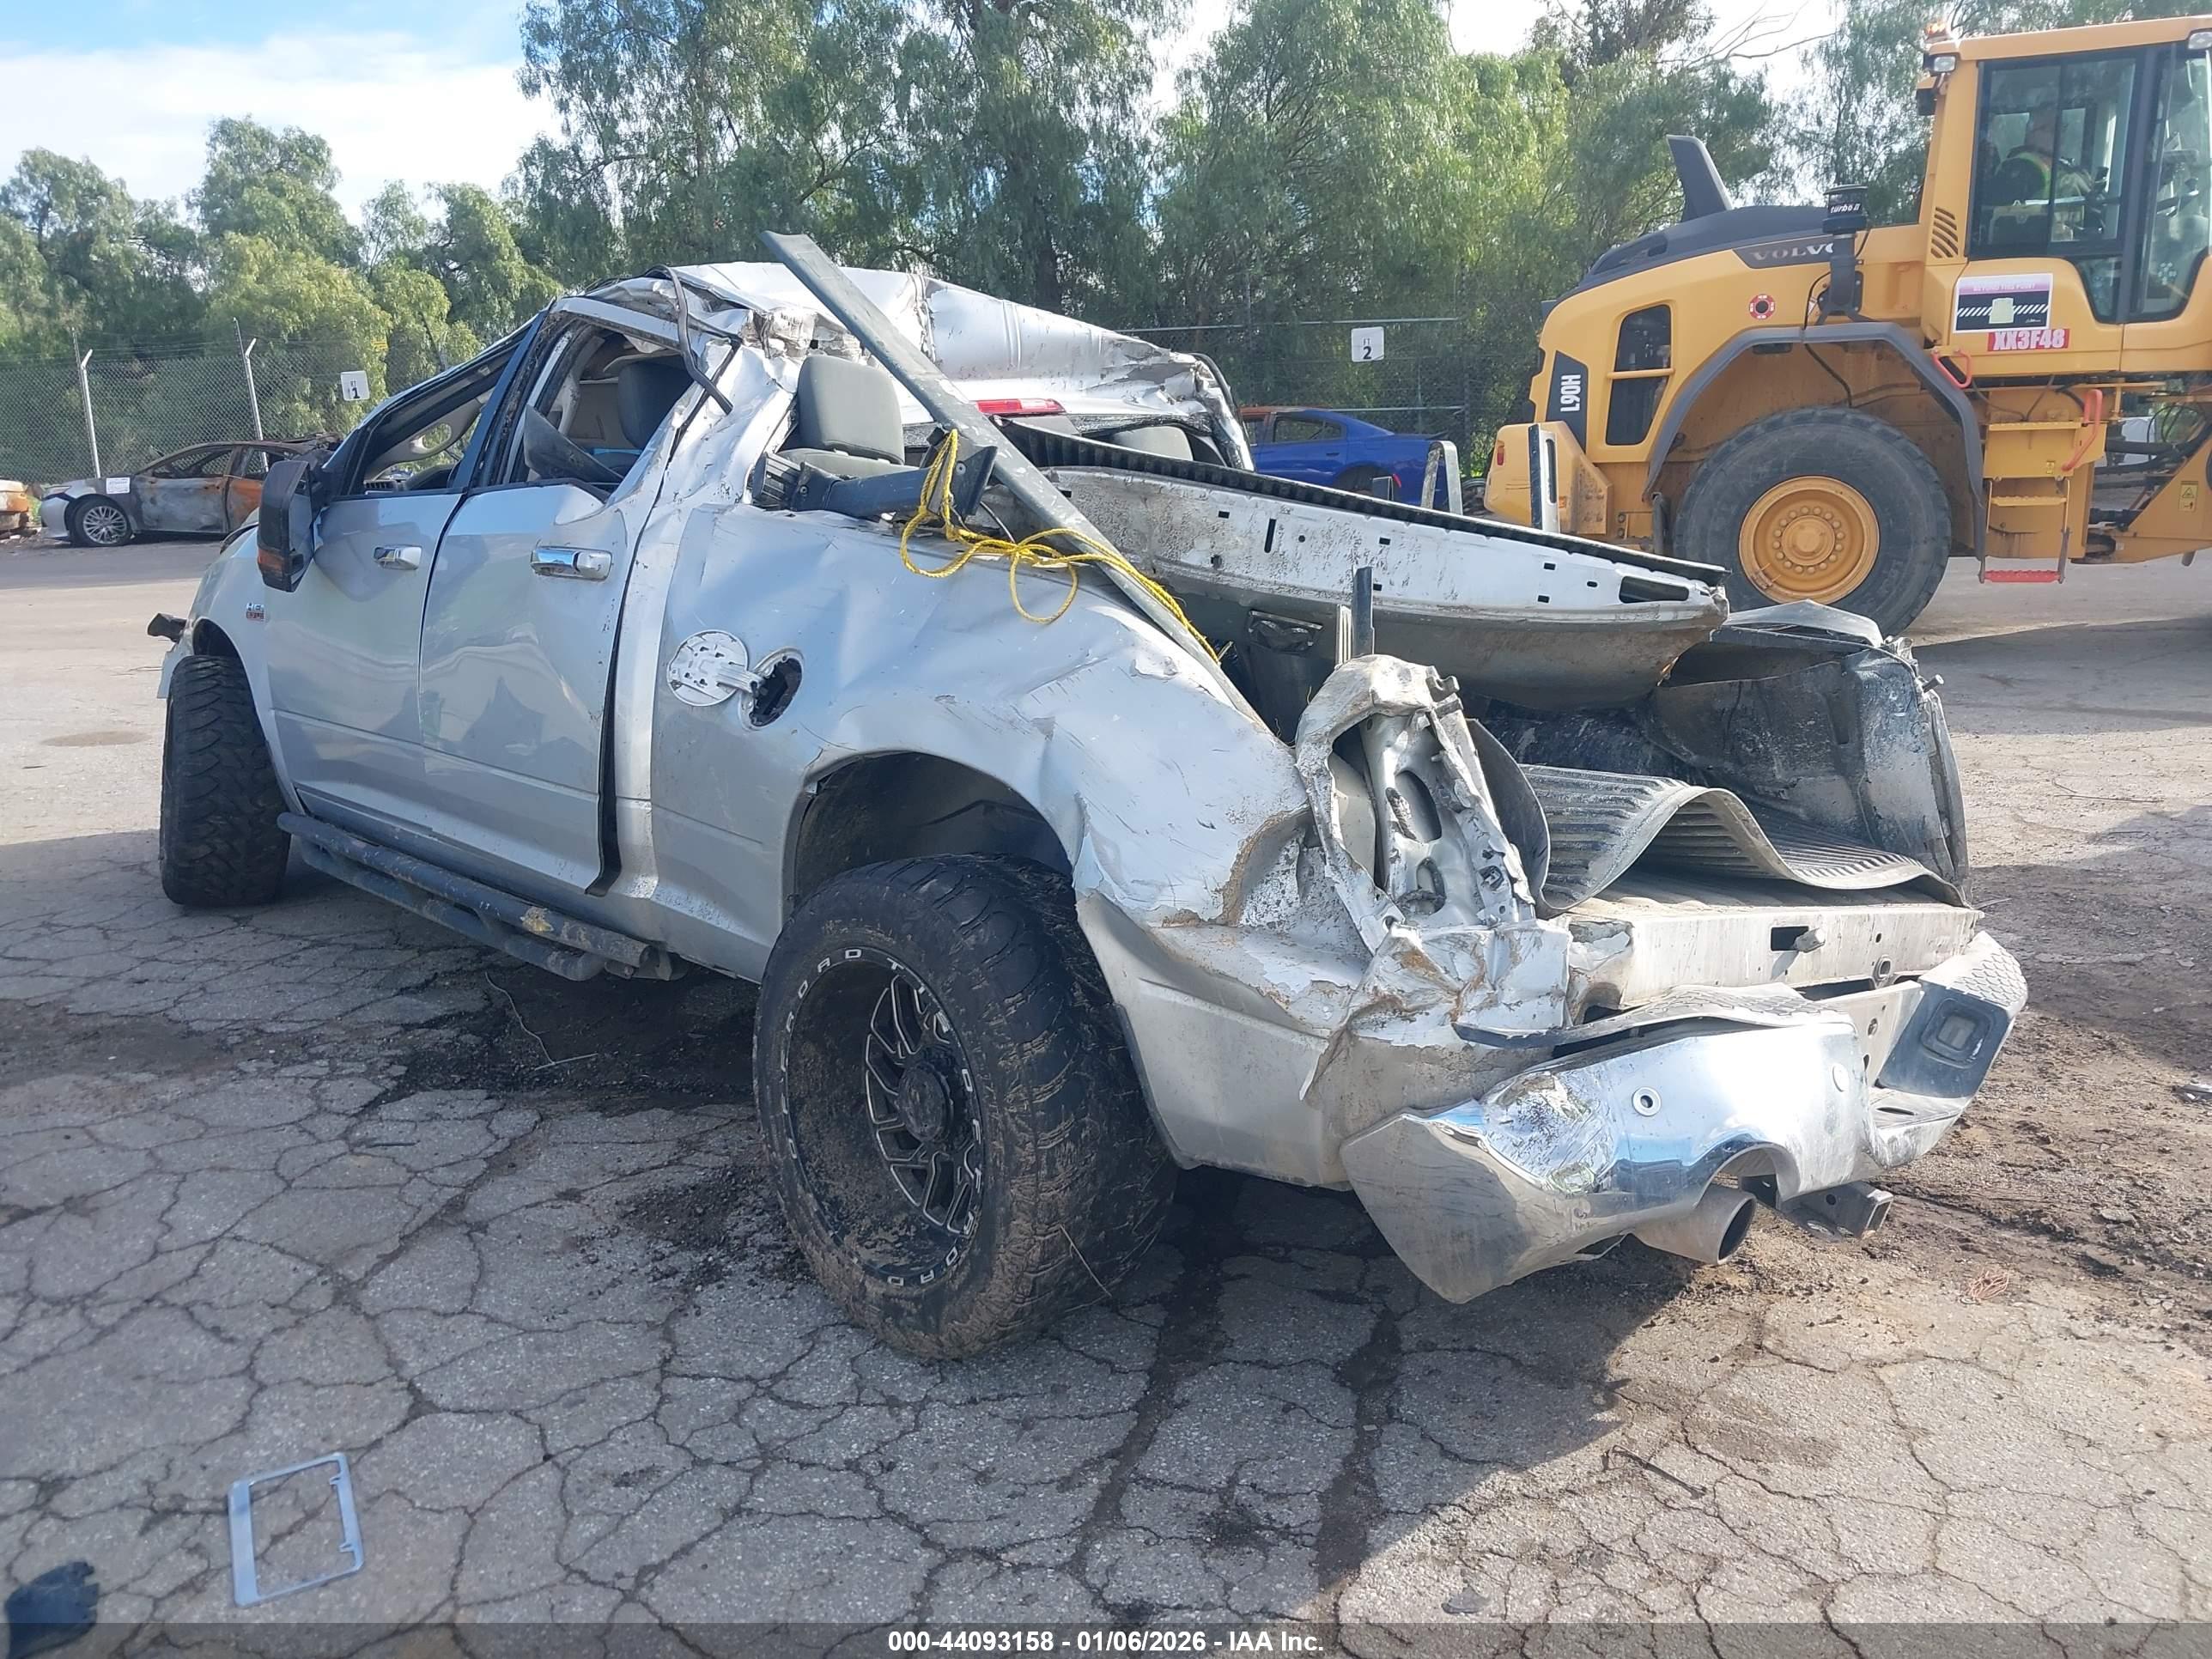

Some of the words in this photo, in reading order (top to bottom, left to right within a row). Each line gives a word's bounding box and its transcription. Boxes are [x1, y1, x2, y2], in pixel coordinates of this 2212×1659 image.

[1830, 204, 1853, 214] turbo
[1993, 329, 2065, 351] XX3F48
[1363, 345, 1372, 360] 2
[351, 387, 361, 399] 1
[1559, 374, 1582, 412] L90H
